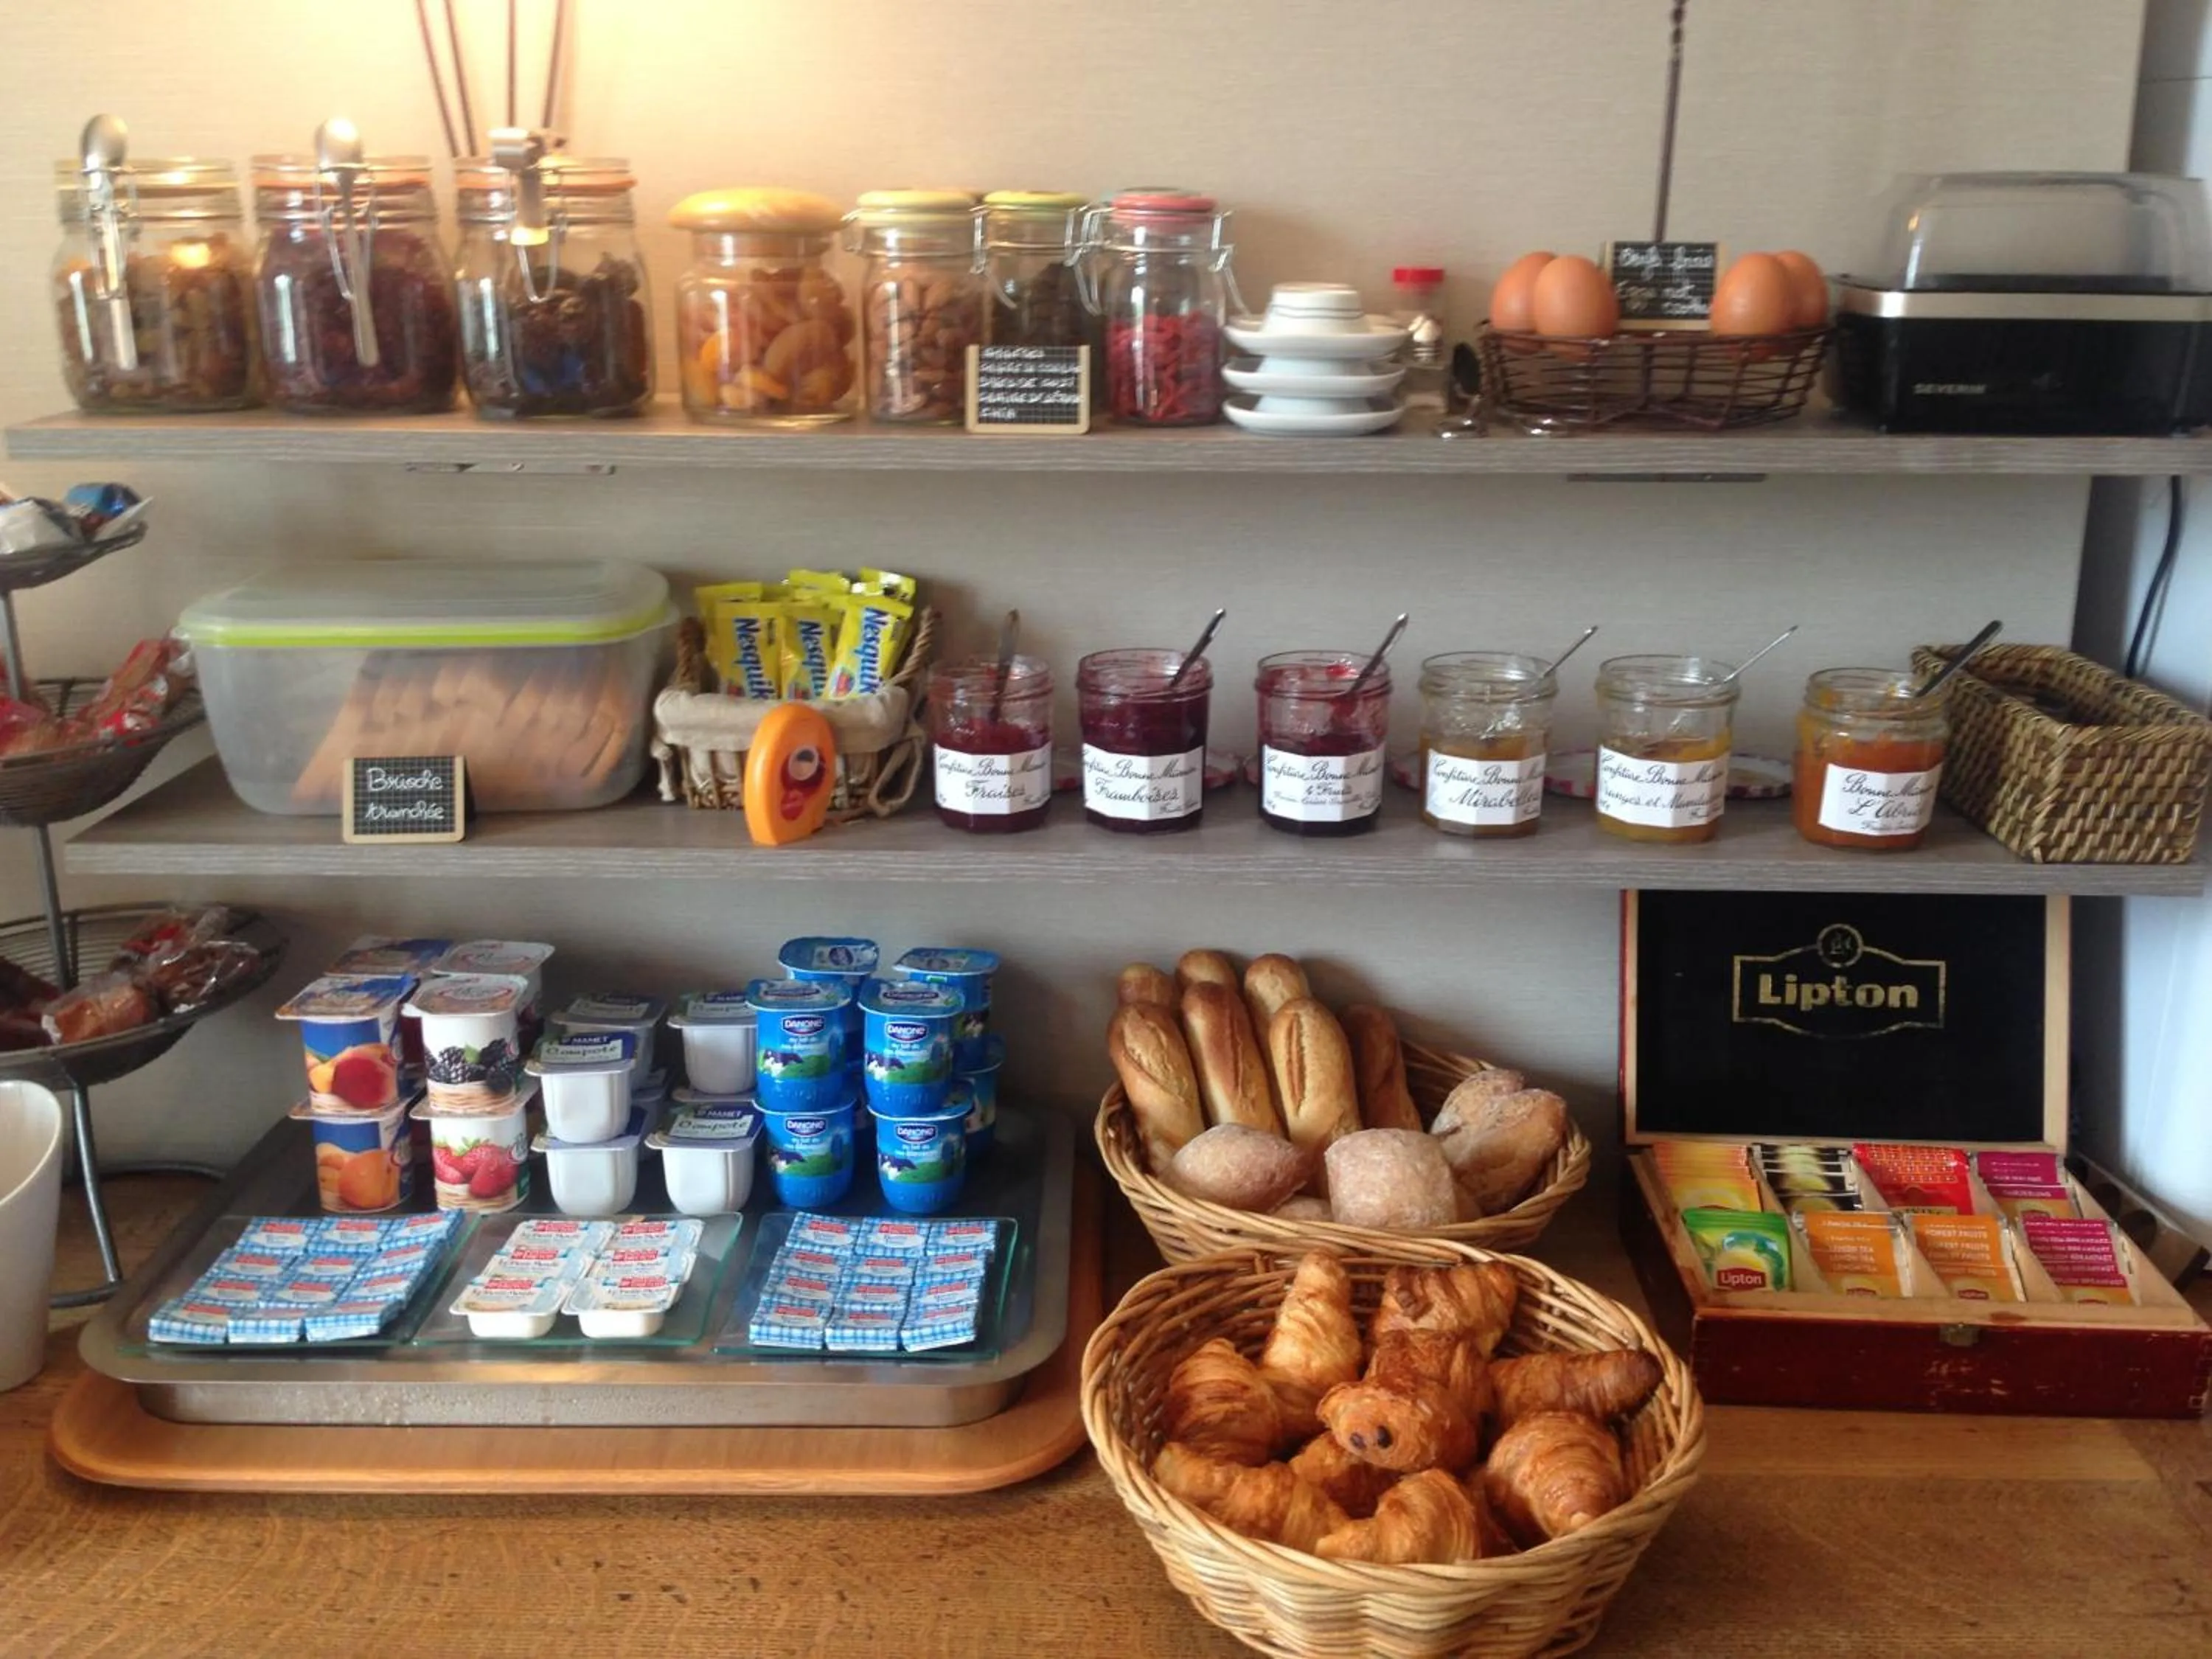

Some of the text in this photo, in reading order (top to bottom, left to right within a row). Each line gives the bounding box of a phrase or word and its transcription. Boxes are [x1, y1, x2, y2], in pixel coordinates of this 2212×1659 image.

[734, 617, 775, 699] Nesquik
[854, 607, 888, 695] Nesquik
[366, 768, 444, 791] Brioche
[1110, 758, 1156, 780] Bonne
[1304, 759, 1349, 780] Bonne
[1475, 764, 1521, 785] Bonne
[1642, 765, 1687, 785] Bonne
[964, 779, 1026, 799] Fraises
[1094, 776, 1179, 802] Framboises
[1843, 773, 1892, 797] Bonne
[366, 800, 445, 821] tranchée
[1758, 973, 1919, 1011] Lipton
[785, 1019, 823, 1029] DANONE
[887, 1024, 926, 1034] DANONE
[787, 1120, 825, 1130] DANONE
[897, 1127, 934, 1136] DANONE
[1720, 1272, 1761, 1287] Lipton
